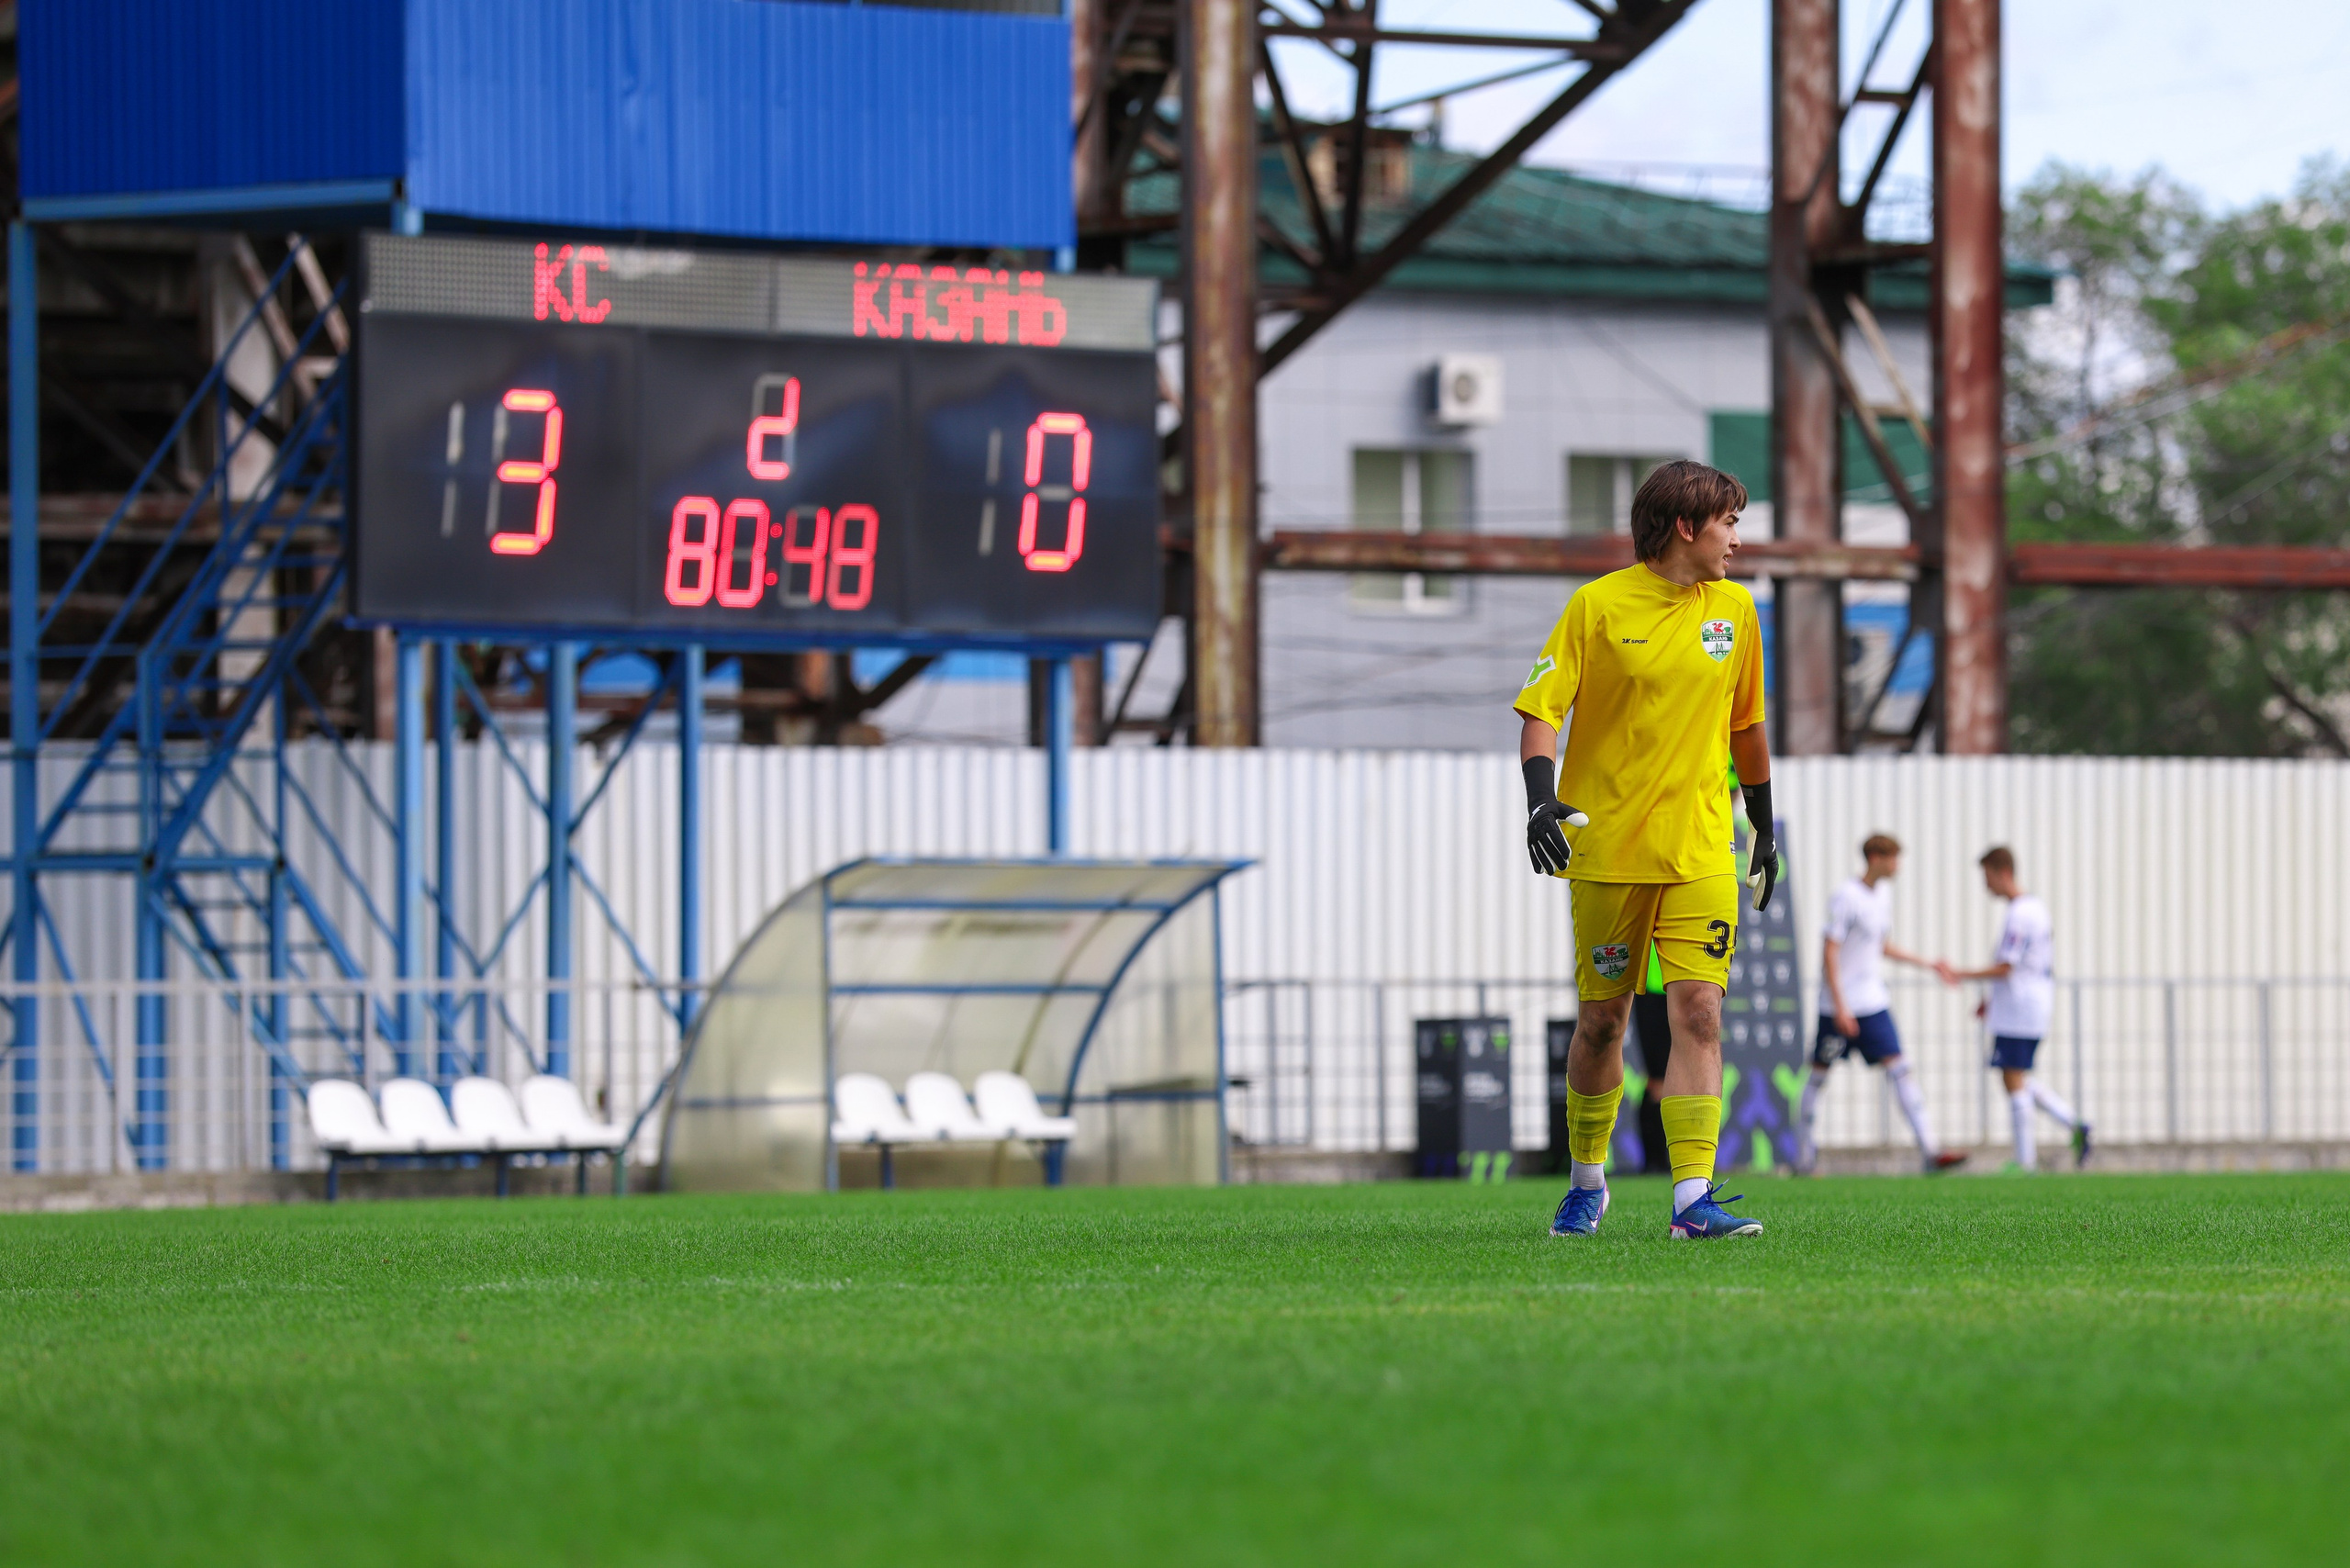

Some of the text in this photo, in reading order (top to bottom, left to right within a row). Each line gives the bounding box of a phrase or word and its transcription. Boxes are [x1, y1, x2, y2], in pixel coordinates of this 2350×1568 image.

[534, 241, 611, 324] КС
[854, 261, 1067, 347] КАЗАНЬ
[491, 388, 563, 554] 3
[746, 376, 800, 480] 2
[1018, 412, 1092, 572] 0
[665, 496, 879, 610] 80:48
